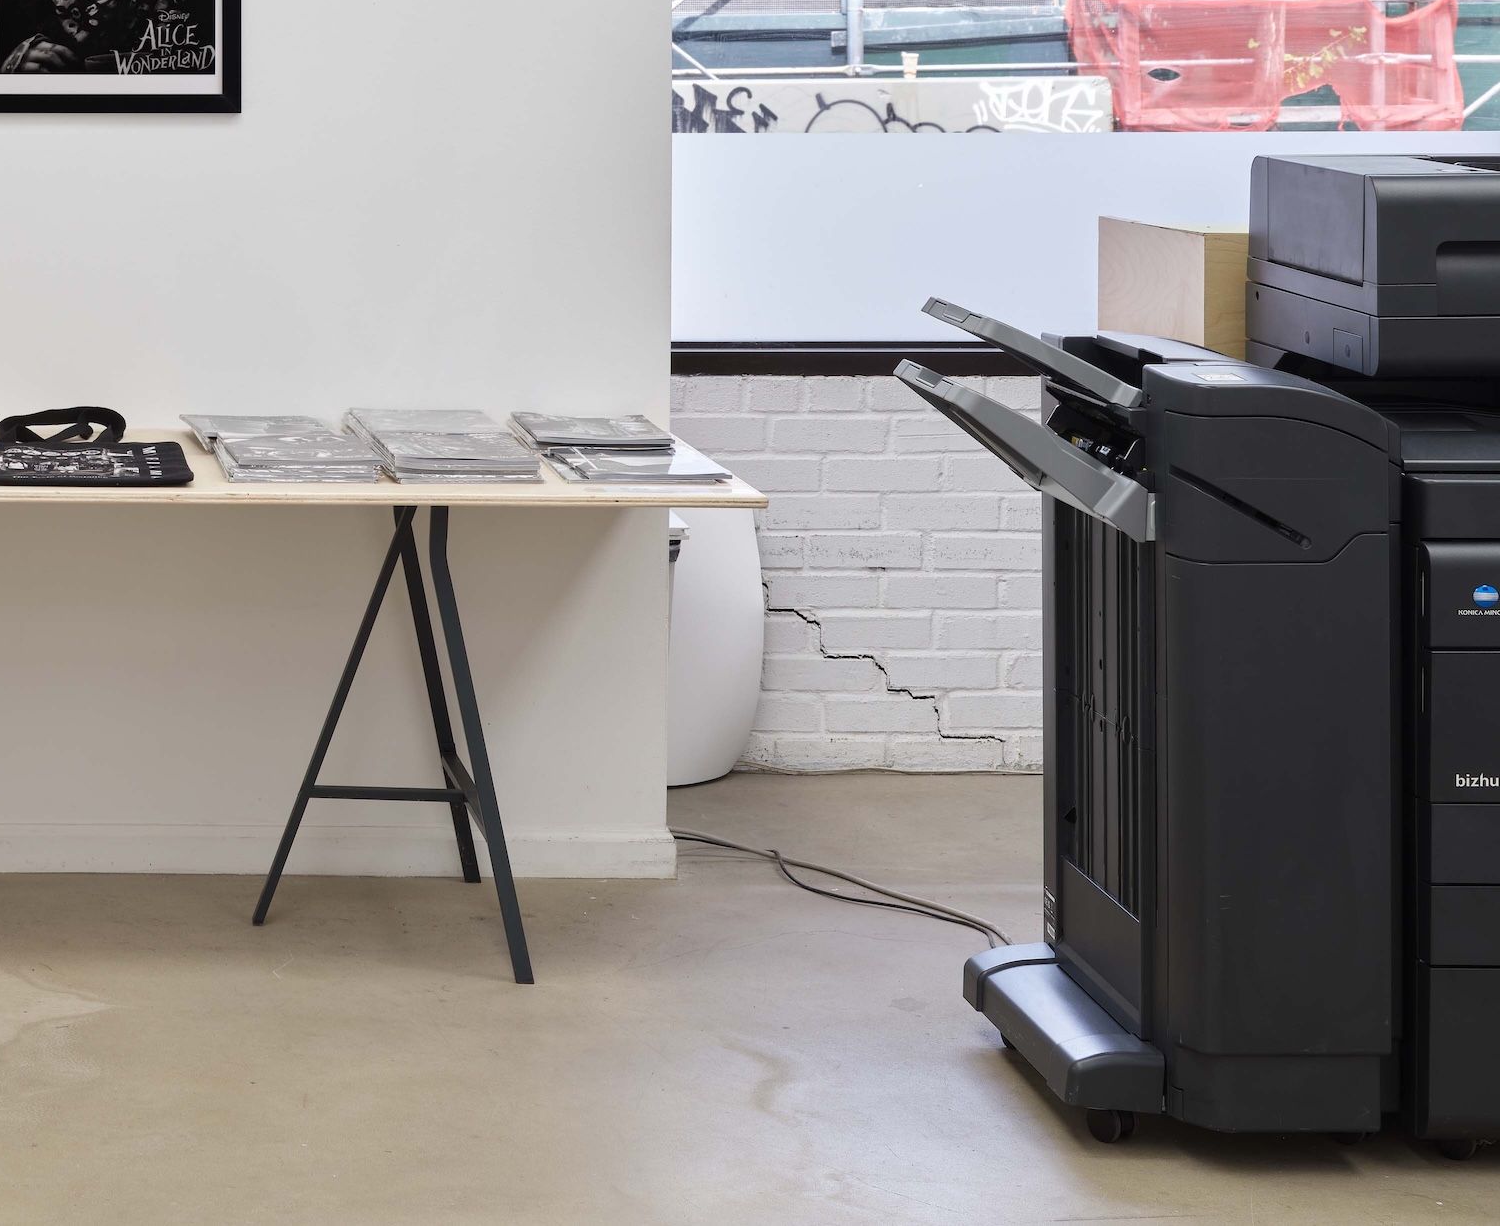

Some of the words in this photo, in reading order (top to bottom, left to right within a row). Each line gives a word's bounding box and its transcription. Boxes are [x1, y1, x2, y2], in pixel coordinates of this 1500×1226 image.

[132, 18, 200, 53] ALICE
[109, 45, 216, 75] WONDERLAND
[160, 48, 172, 56] IN
[1455, 772, 1500, 787] bizhu
